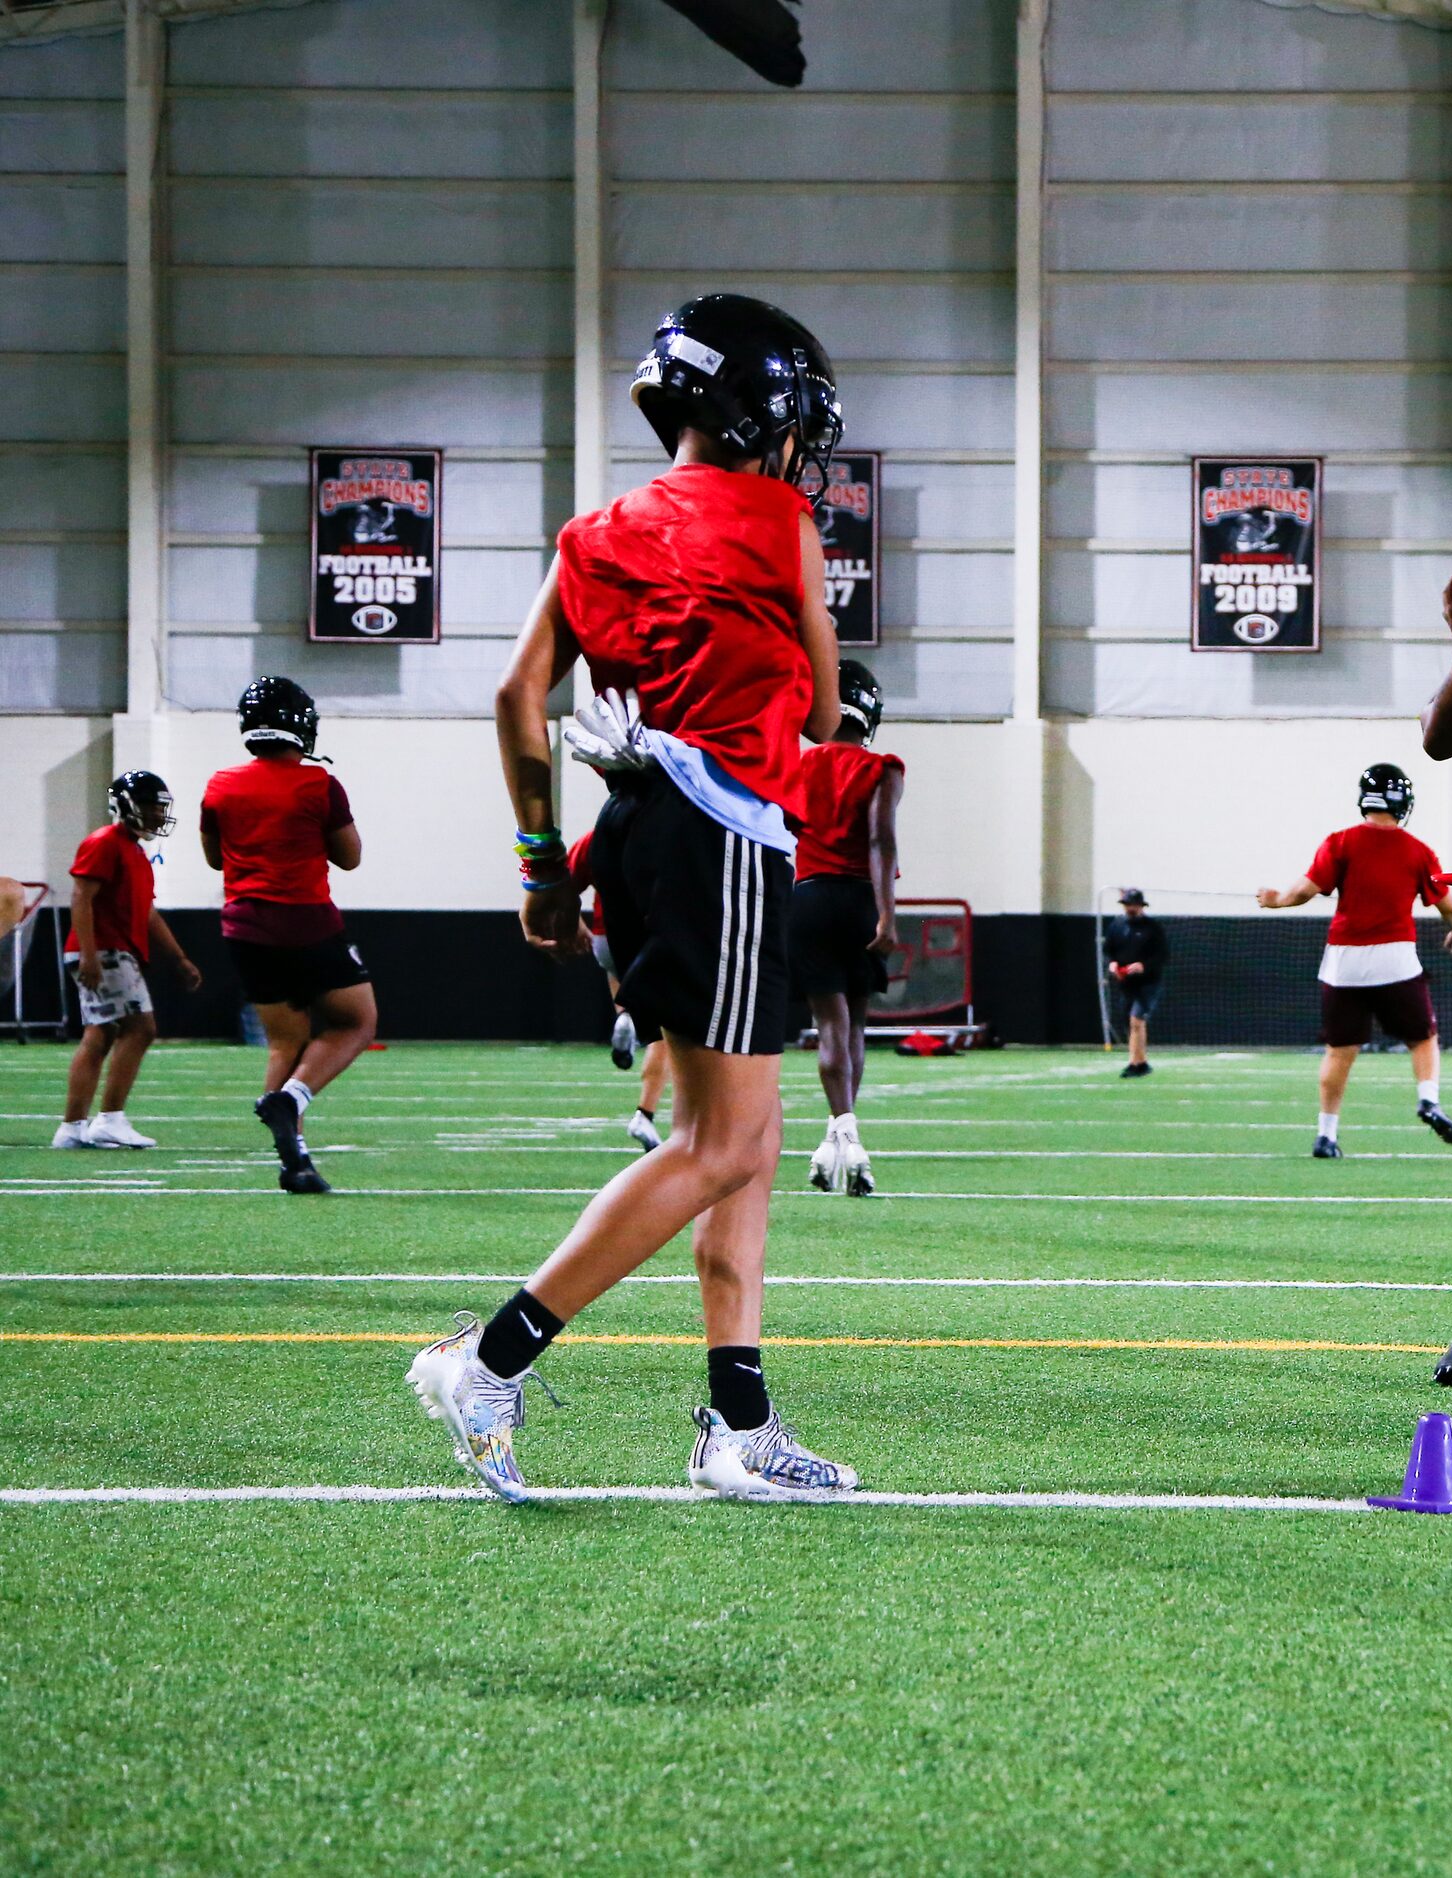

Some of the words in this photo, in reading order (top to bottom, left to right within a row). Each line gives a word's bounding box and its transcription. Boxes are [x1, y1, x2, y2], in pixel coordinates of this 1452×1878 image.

[1223, 467, 1291, 486] STATE
[321, 479, 431, 515] CHAMPIONS
[1204, 487, 1311, 523] CHAMPIONS
[319, 554, 432, 577] FOOTBALL
[1200, 563, 1312, 585] FOOTBALL
[333, 576, 417, 604] 2005
[1215, 585, 1298, 613] 2009
